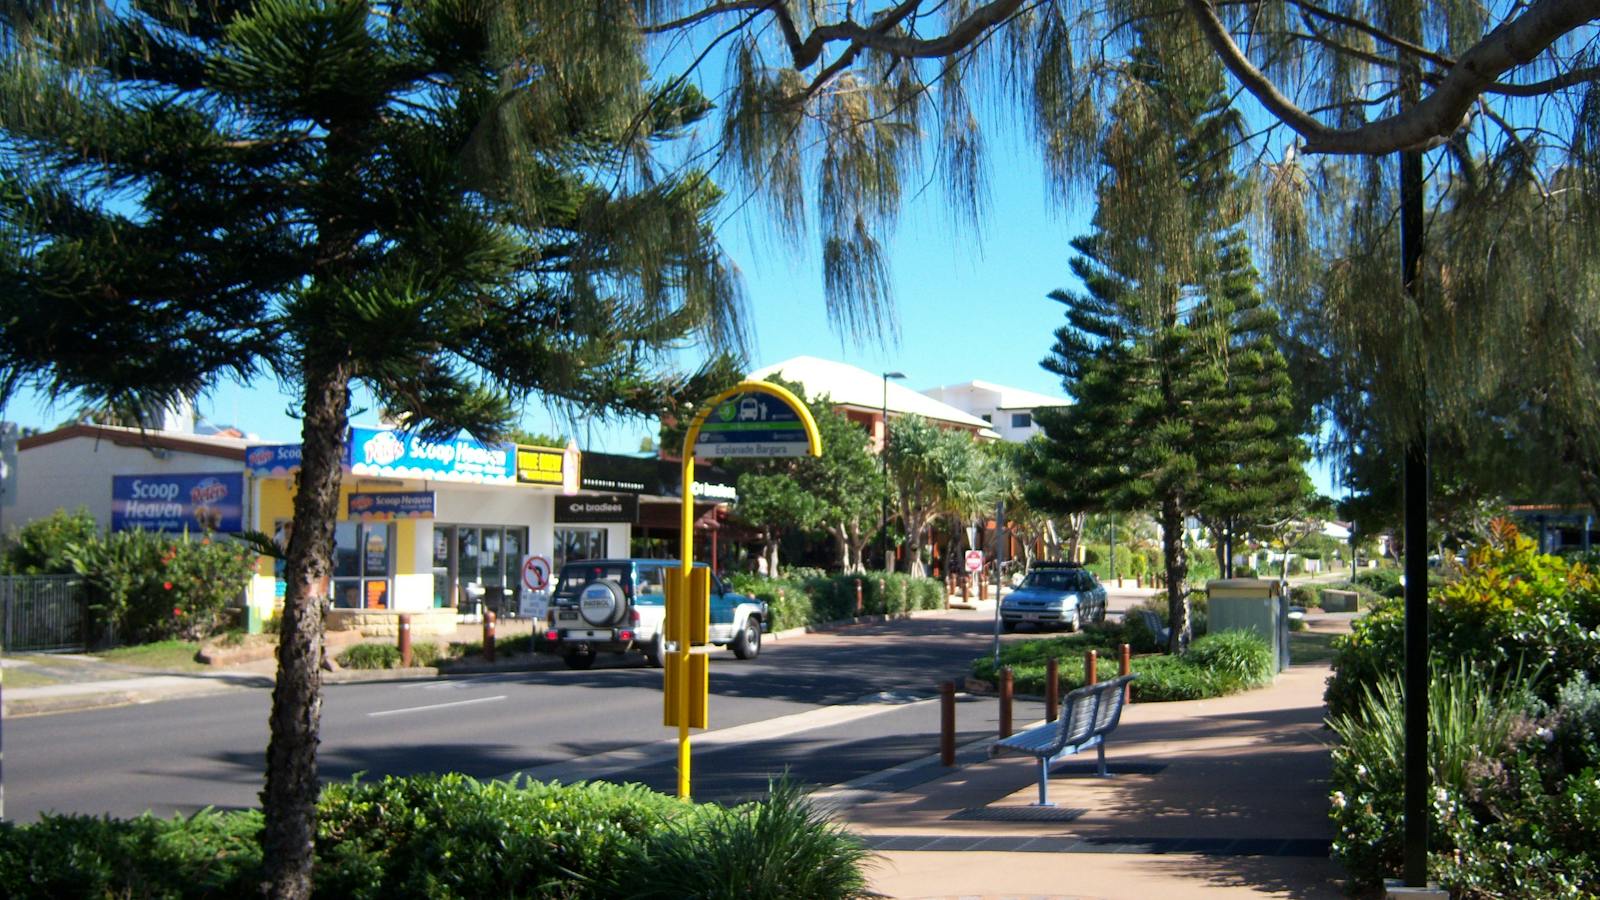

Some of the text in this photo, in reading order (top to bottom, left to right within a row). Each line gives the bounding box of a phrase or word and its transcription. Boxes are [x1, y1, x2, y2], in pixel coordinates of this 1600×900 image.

[277, 447, 303, 459] Scoo
[715, 444, 787, 456] Esplanade Bargara
[131, 479, 179, 501] Scoop
[375, 495, 401, 506] Scoop
[401, 495, 432, 505] Heaven
[125, 501, 183, 518] Heaven
[584, 600, 609, 608] PATROL
